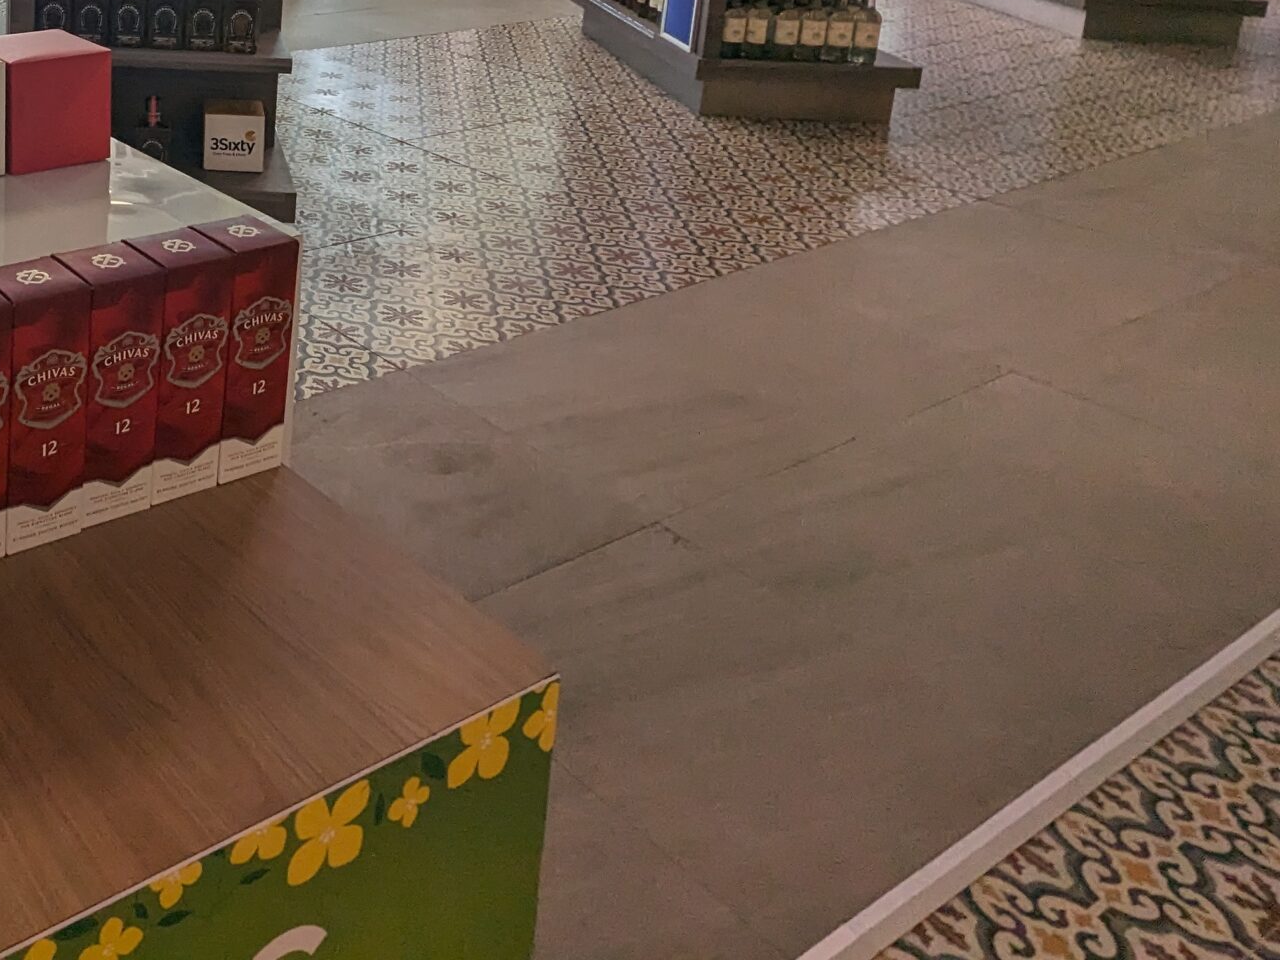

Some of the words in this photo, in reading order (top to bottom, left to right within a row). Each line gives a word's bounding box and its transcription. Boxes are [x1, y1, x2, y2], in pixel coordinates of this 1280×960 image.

[210, 138, 256, 154] 3Sixty
[244, 312, 283, 330] CHIVAS
[176, 330, 218, 348] CHIVAS
[104, 348, 150, 366] CHIVAS
[28, 366, 76, 386] CHIVAS
[252, 380, 266, 395] 12
[186, 398, 200, 414] 12
[115, 418, 130, 434] 12
[42, 440, 58, 457] 12
